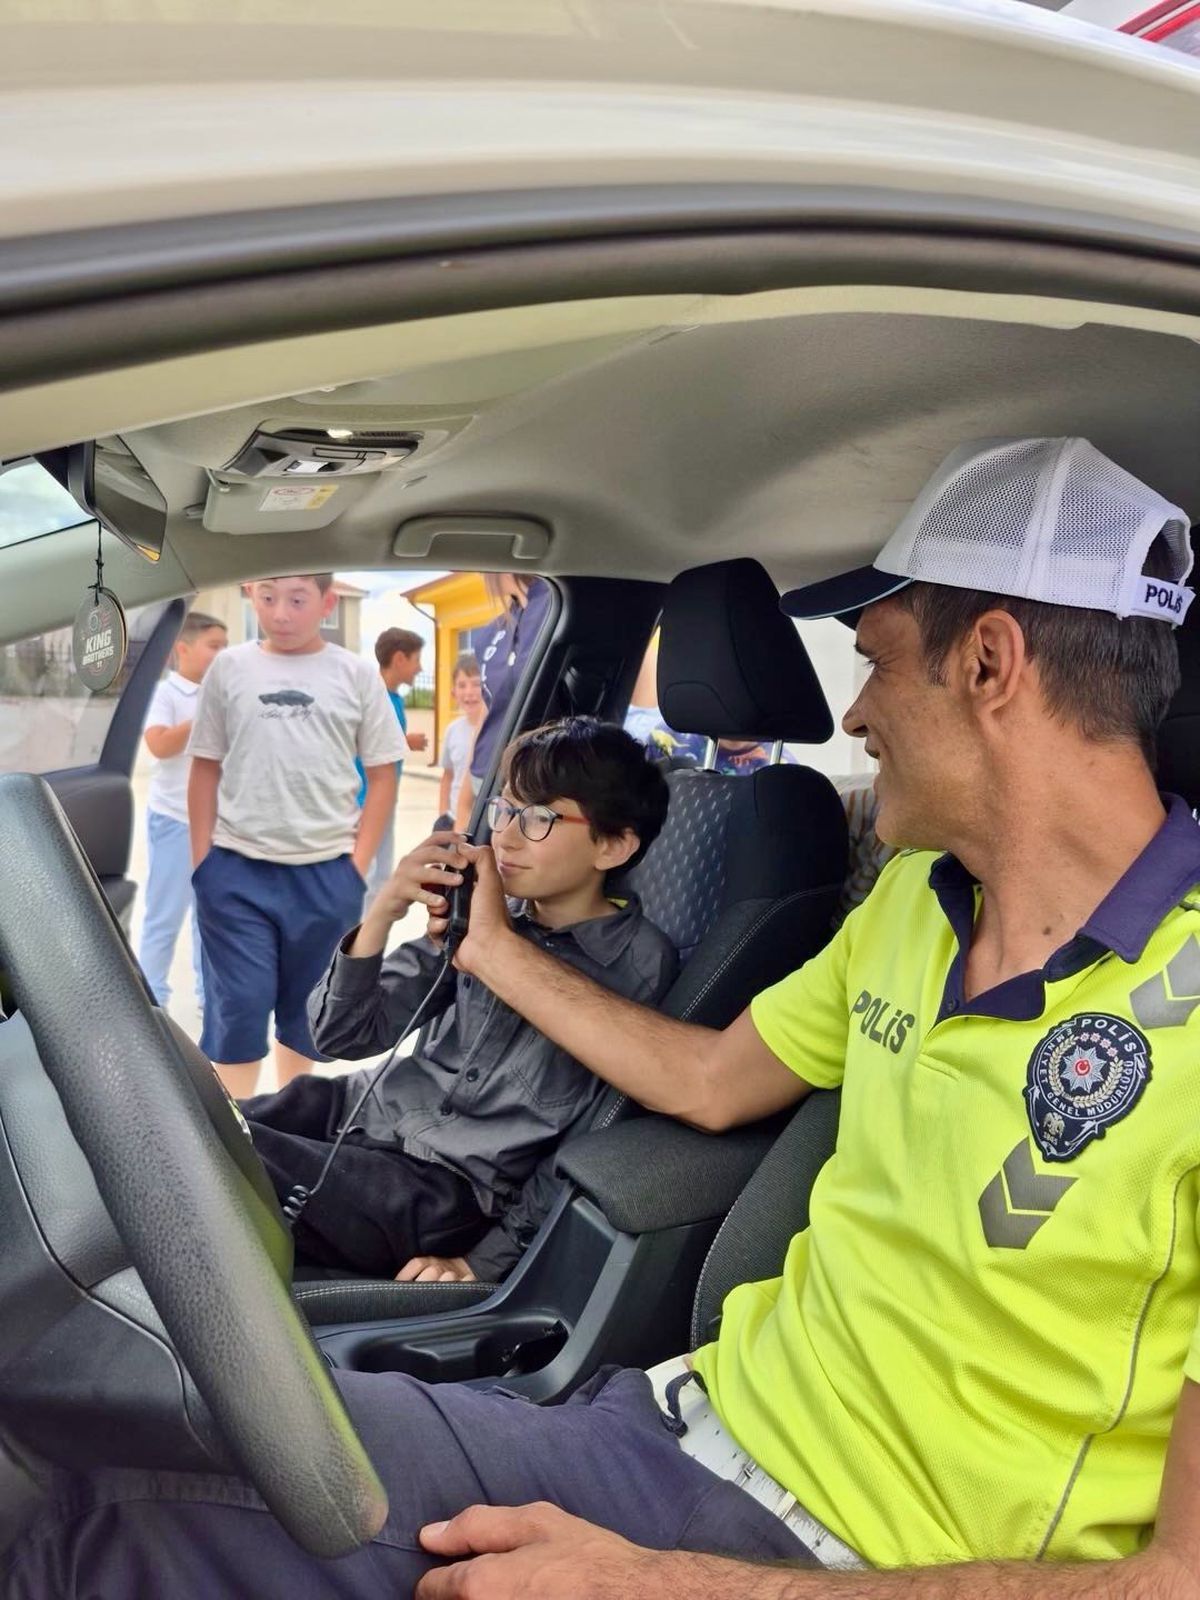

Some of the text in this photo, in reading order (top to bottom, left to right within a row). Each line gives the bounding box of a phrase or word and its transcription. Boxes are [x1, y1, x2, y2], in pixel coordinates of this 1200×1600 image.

[86, 629, 112, 654] KING
[849, 990, 916, 1054] POLİS
[1081, 1018, 1137, 1051] POLİS
[1047, 1092, 1080, 1117] GENEL
